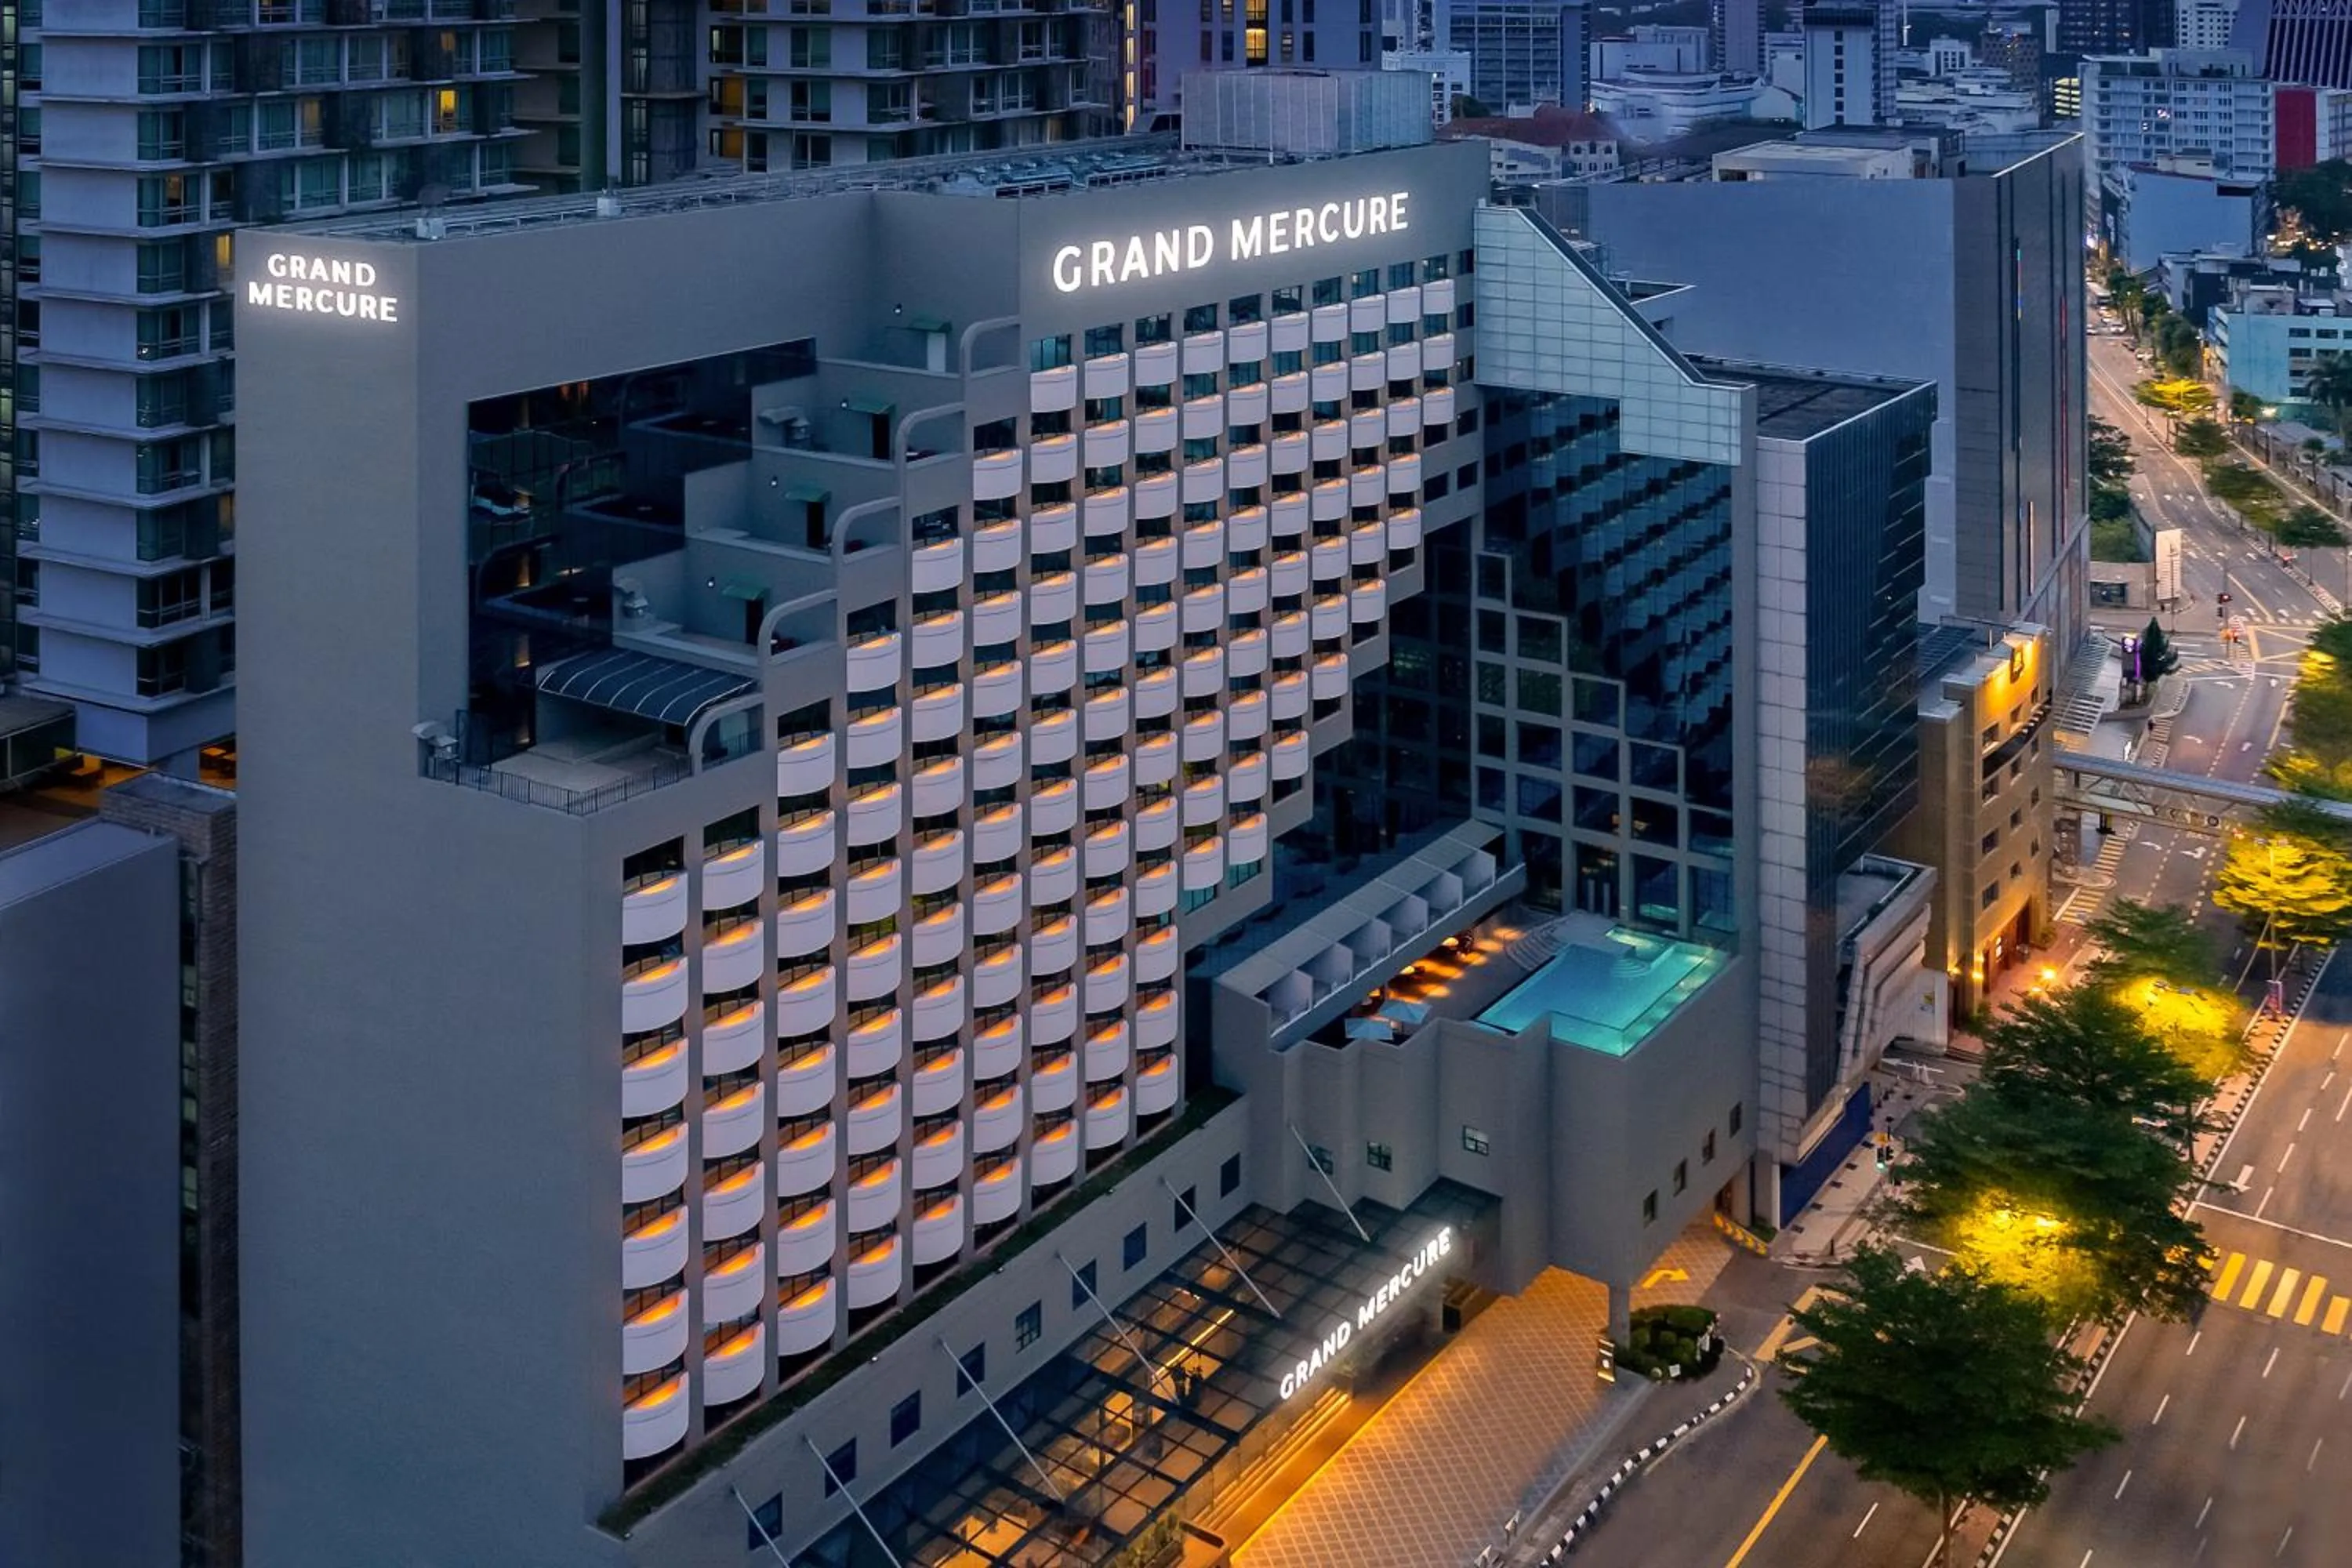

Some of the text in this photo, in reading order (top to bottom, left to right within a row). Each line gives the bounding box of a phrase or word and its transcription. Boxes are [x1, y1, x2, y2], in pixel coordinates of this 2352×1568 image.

[267, 253, 377, 288] GRAND
[1052, 192, 1410, 293] GRAND MERCURE
[248, 281, 398, 323] MERCURE
[1279, 1226, 1451, 1400] GRAND MERCURE
